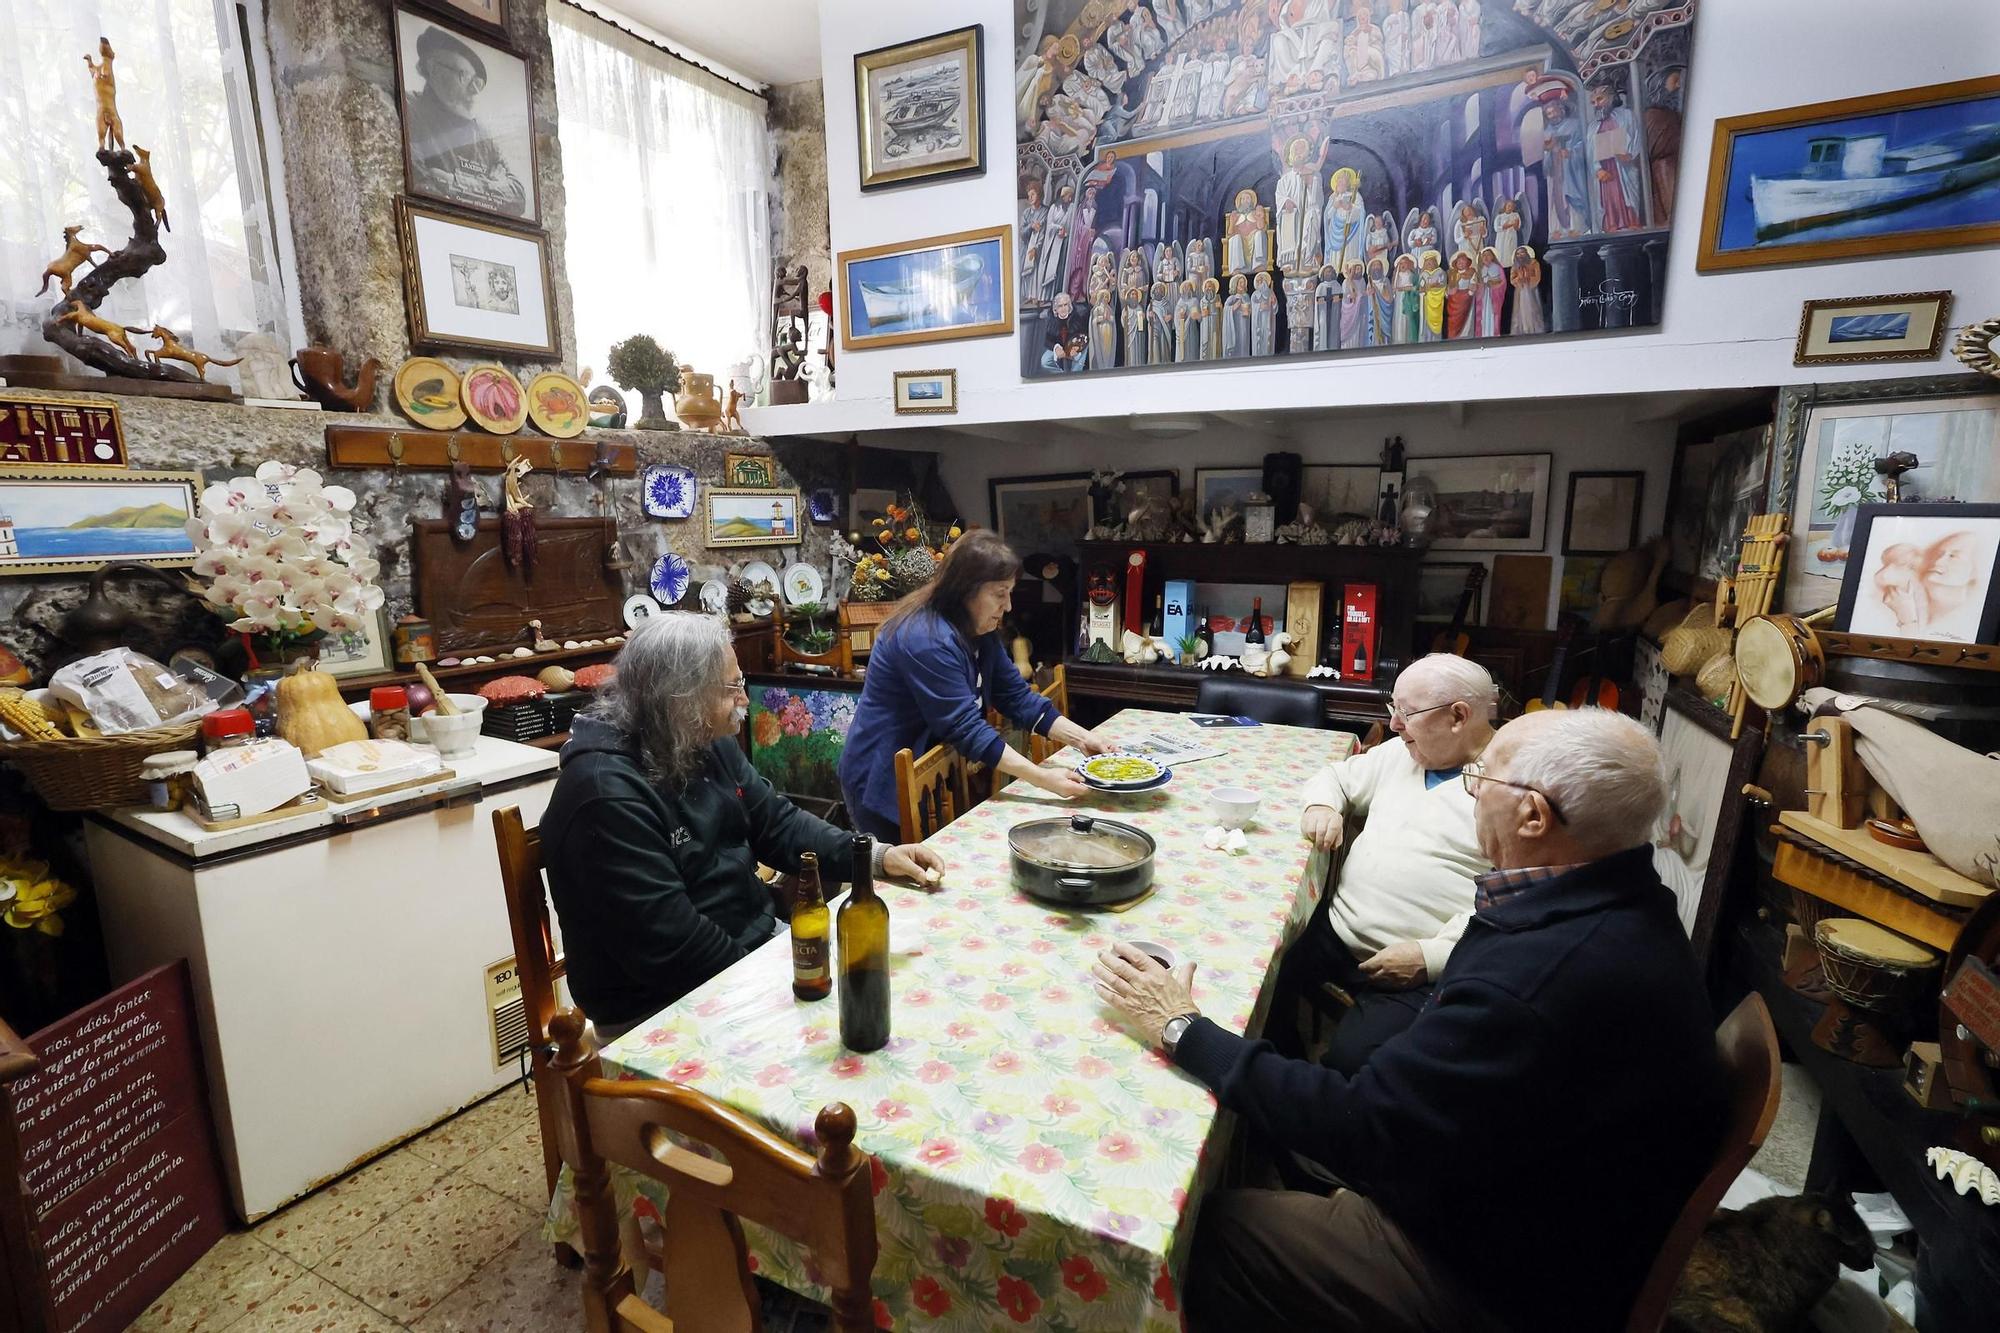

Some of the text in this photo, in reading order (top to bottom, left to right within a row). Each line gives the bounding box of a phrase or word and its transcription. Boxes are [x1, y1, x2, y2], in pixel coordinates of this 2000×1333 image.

[493, 969, 512, 984] 180
[43, 1072, 76, 1096] vista
[80, 1056, 101, 1075] dos
[103, 1038, 132, 1060] meus
[44, 1043, 91, 1075] regatos
[19, 1117, 35, 1132] on
[39, 1102, 57, 1120] sei
[60, 1076, 97, 1107] cando
[100, 1063, 121, 1082] nos
[24, 1138, 53, 1161] iña
[94, 1091, 123, 1115] miña
[25, 1159, 52, 1182] erra
[55, 1130, 93, 1161] donde
[95, 1116, 112, 1133] me
[115, 1106, 128, 1120] eu
[33, 1164, 71, 1197] ortiña
[76, 1147, 97, 1171] que
[100, 1123, 131, 1152] quero
[97, 1151, 118, 1174] que
[44, 1216, 82, 1249] rados,
[91, 1213, 110, 1237] que
[113, 1188, 142, 1215] move
[144, 1181, 152, 1191] o
[95, 1253, 108, 1272] do
[111, 1234, 134, 1257] meu
